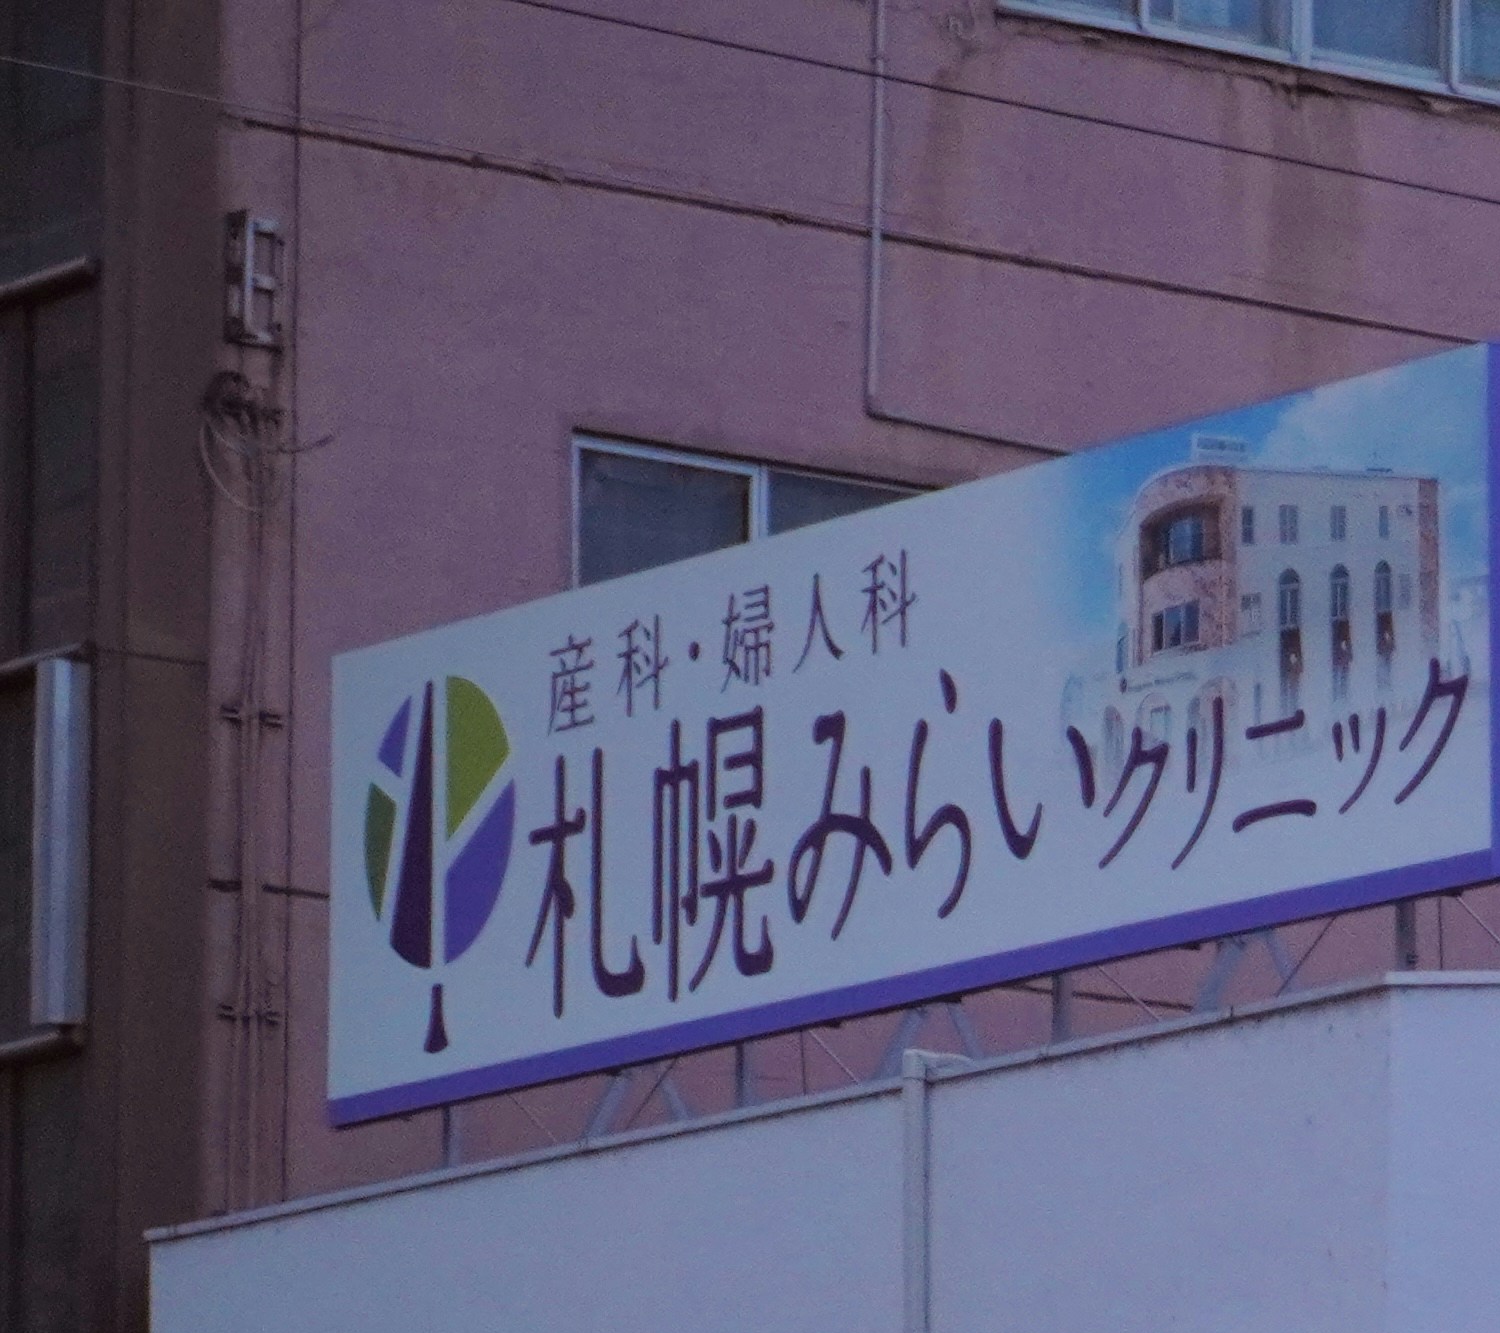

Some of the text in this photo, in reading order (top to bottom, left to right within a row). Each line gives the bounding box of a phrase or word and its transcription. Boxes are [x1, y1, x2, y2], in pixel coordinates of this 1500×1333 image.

[546, 549, 918, 735] 産科・婦人科
[525, 656, 1471, 1020] 札幌みらいクリニック
